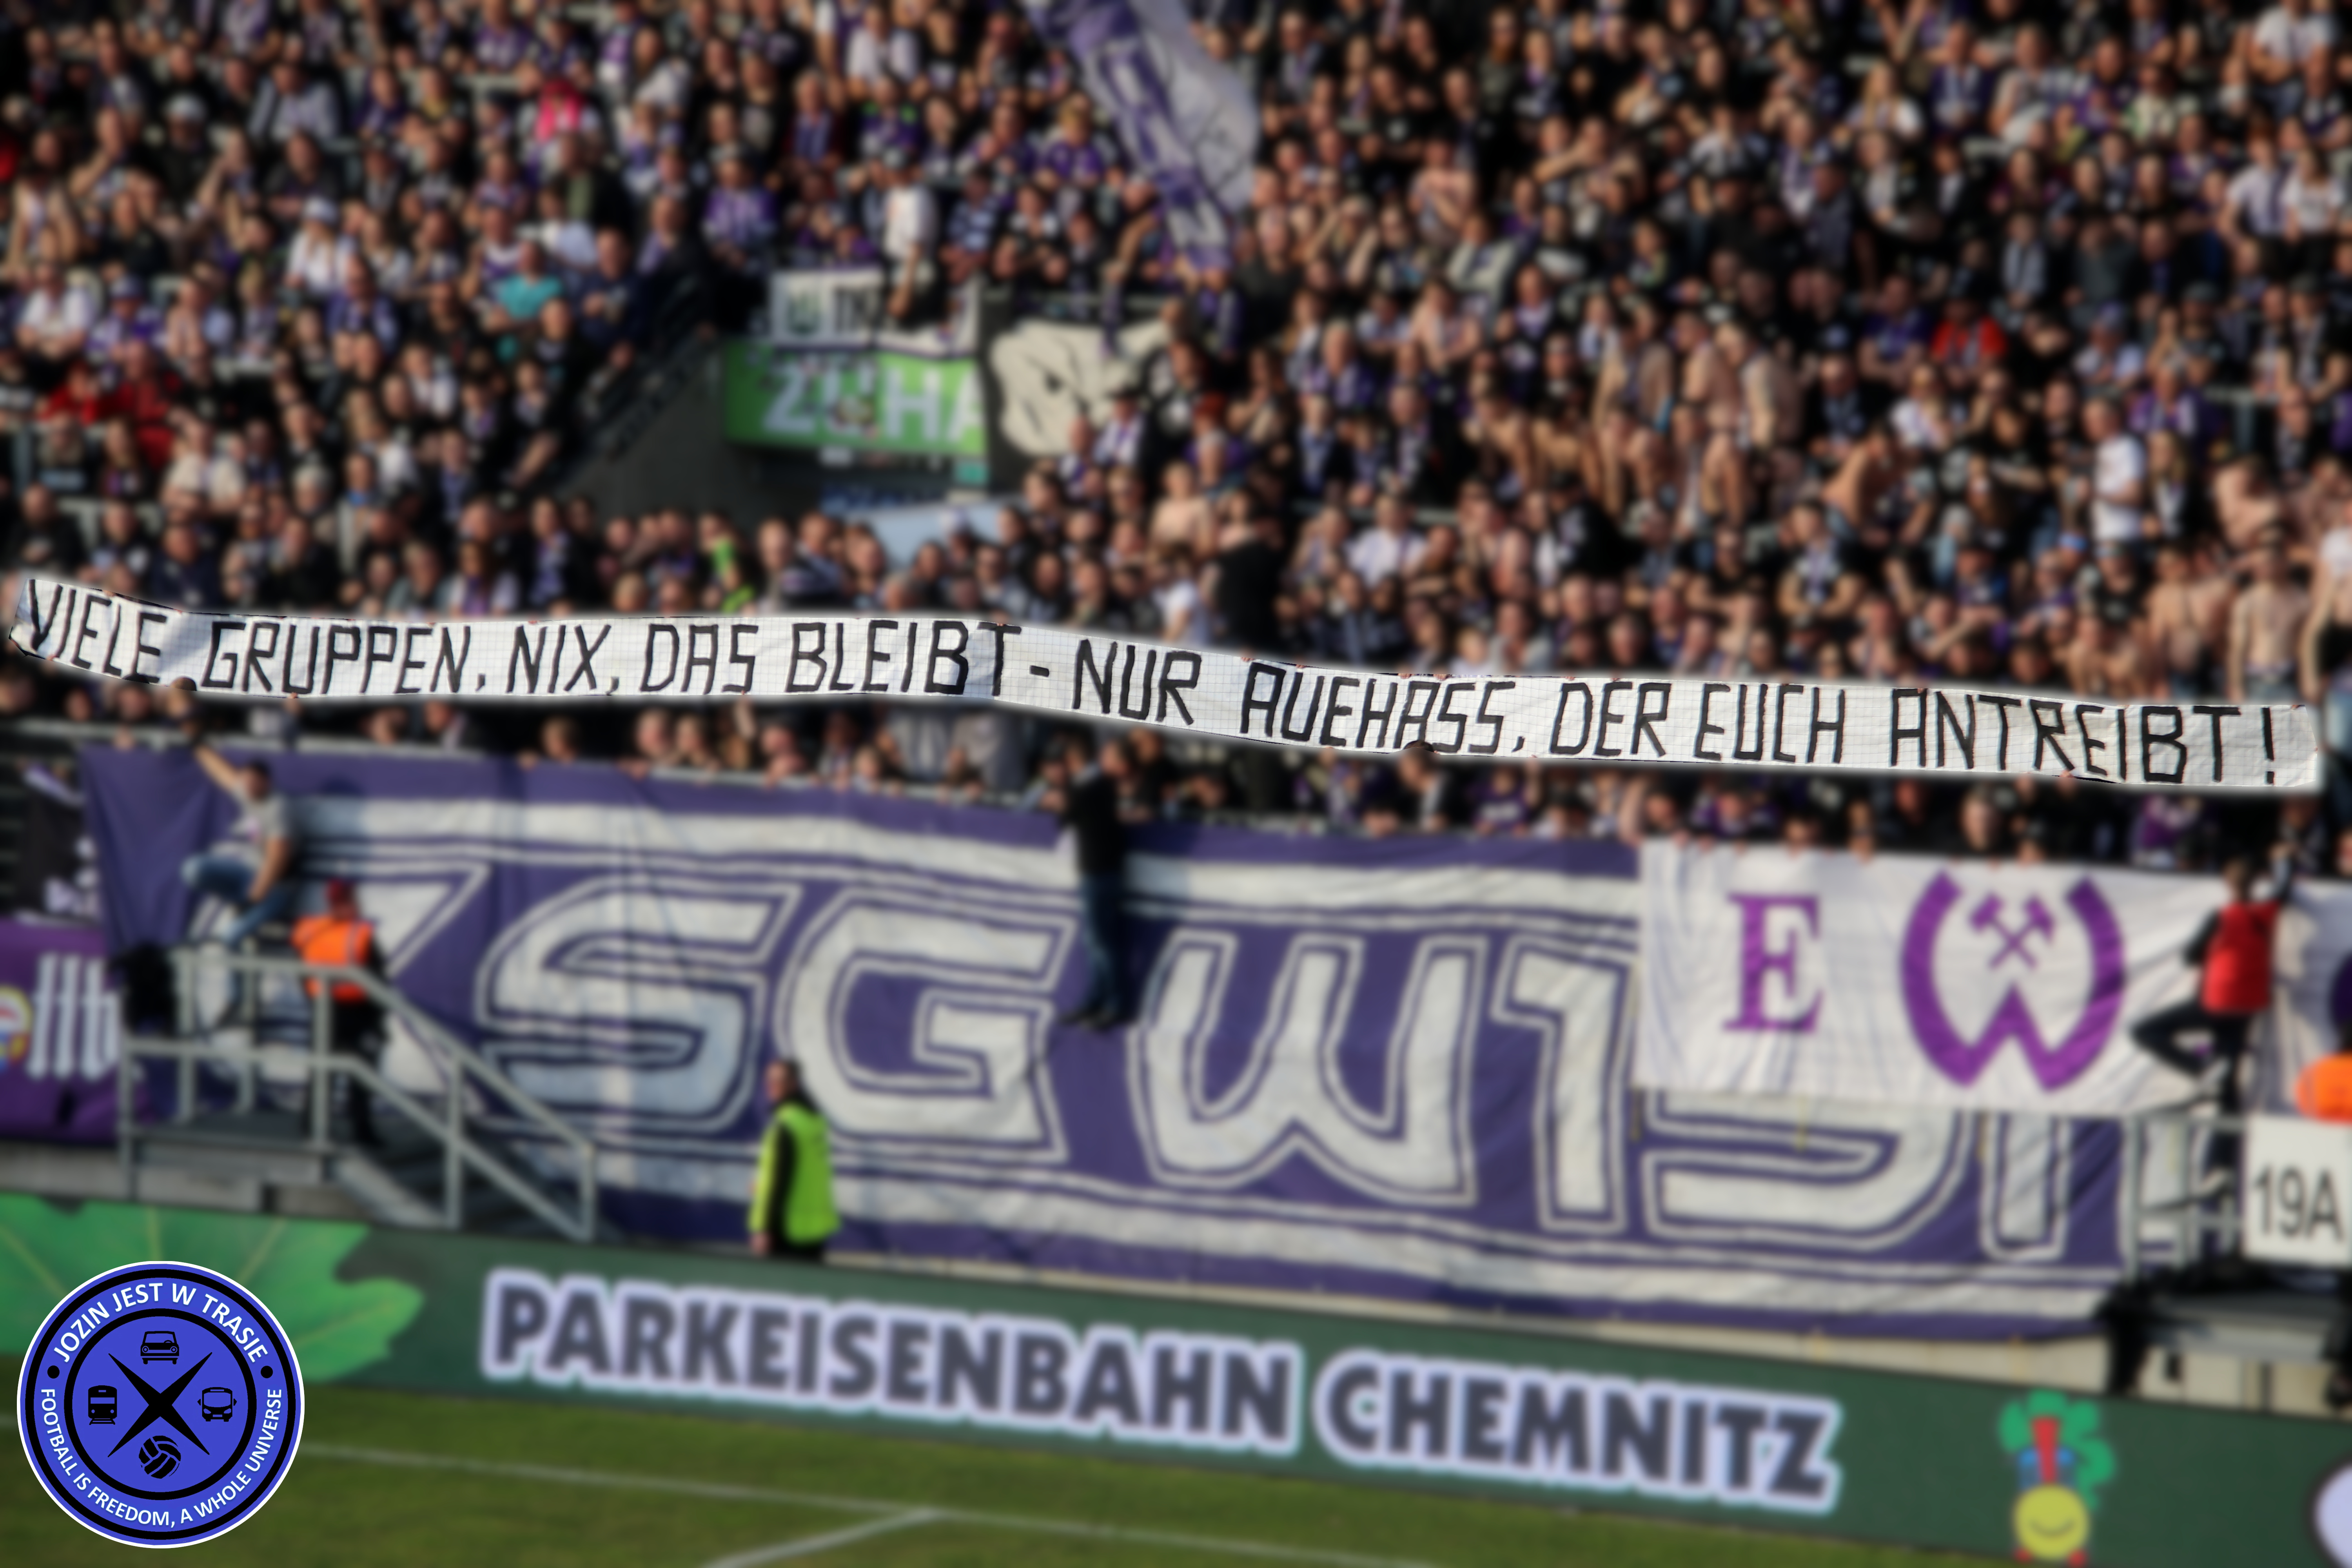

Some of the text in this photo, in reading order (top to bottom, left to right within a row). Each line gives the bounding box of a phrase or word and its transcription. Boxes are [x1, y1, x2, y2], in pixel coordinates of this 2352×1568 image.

[29, 579, 167, 683] VIELE
[201, 621, 486, 694] GRUPPEN,
[506, 624, 619, 695] NIX,
[640, 624, 759, 694] DAS
[785, 620, 1021, 696] BLEIBT
[1072, 639, 1201, 725] NUR
[1550, 681, 1672, 757] DER
[1693, 682, 1845, 763] EUCH
[1889, 688, 2274, 784] ANTREIBT!
[2252, 1163, 2345, 1243] 19A
[492, 1280, 1832, 1500] PARKEISENBAHN CHEMNITZ
